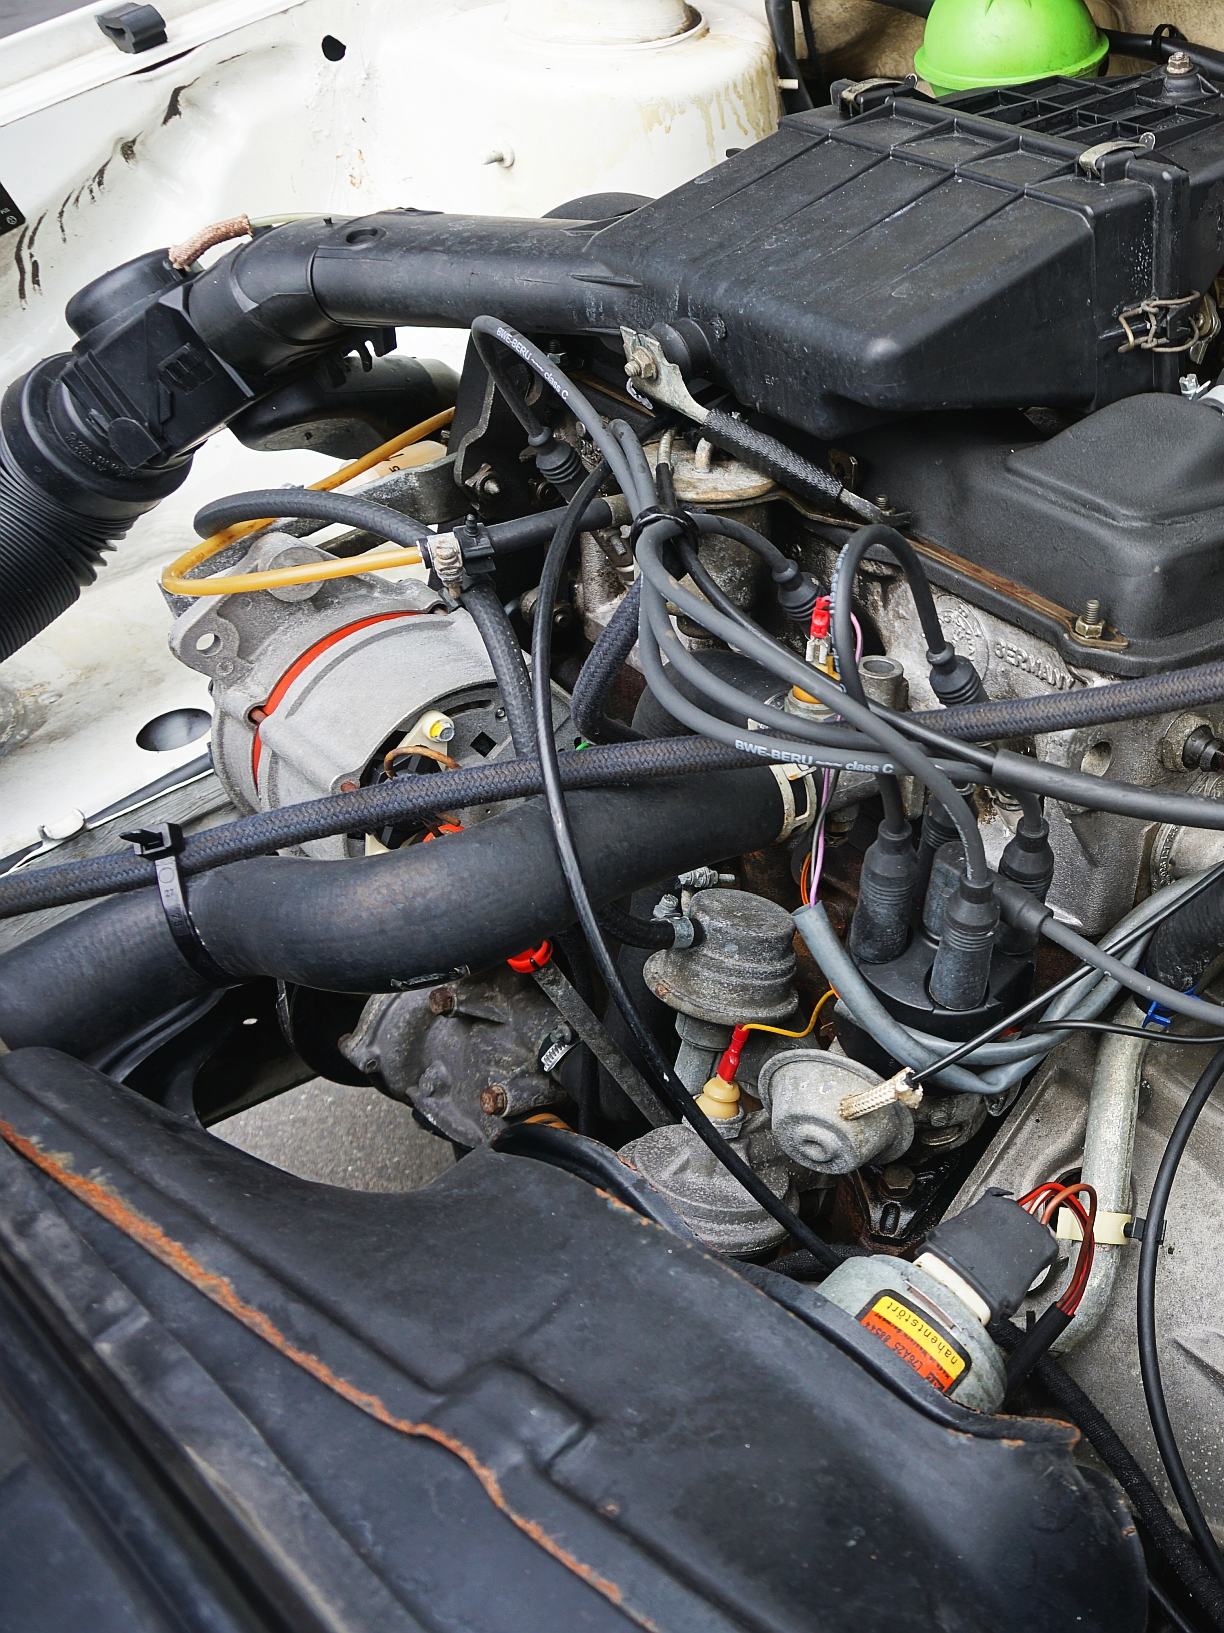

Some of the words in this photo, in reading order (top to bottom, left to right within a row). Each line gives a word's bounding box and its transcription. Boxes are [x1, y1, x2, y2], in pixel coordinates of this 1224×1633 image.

[496, 326, 533, 361] BWE-BERU
[543, 371, 561, 393] class
[561, 389, 569, 400] C
[735, 740, 813, 765] BWE-BERU
[845, 761, 879, 773] class
[882, 763, 894, 774] C
[886, 1302, 958, 1365] nahentstört
